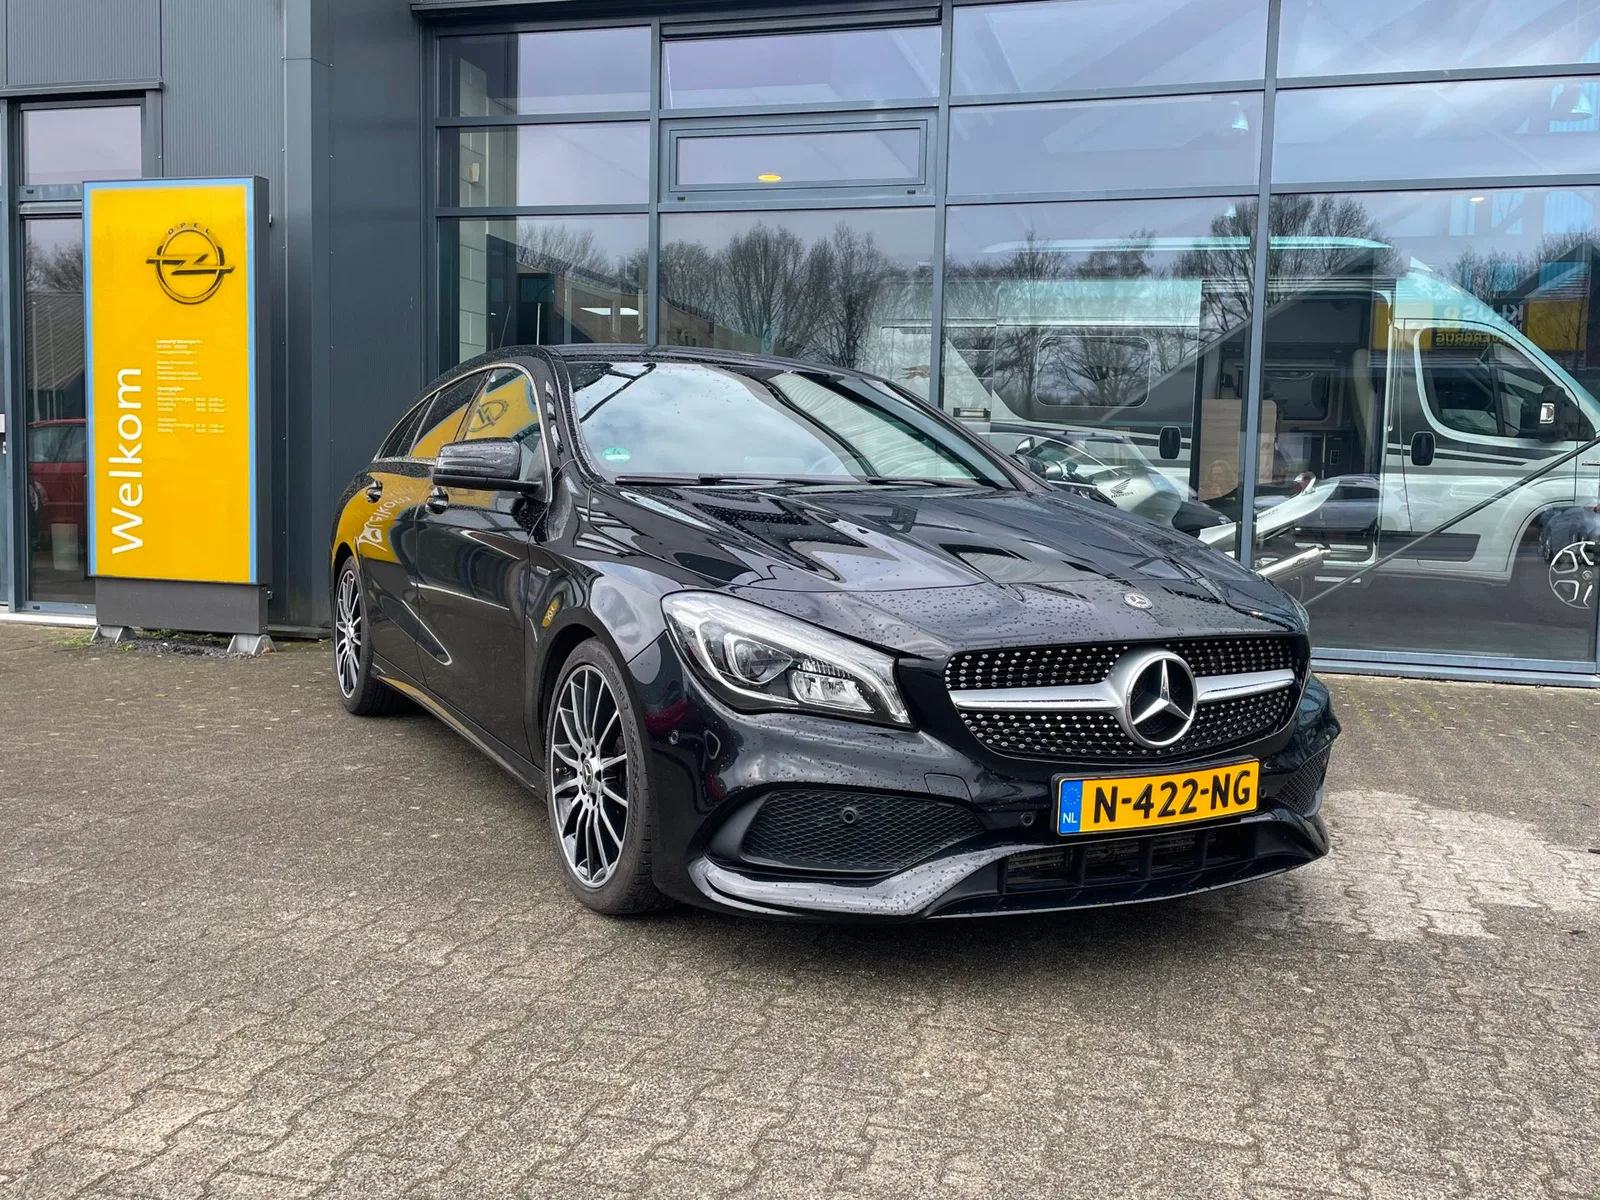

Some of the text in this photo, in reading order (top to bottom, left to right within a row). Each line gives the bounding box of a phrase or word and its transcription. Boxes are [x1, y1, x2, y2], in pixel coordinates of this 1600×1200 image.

[168, 222, 209, 235] OPEL
[108, 368, 143, 554] Welkom
[1093, 770, 1251, 824] N-422-NG
[1062, 812, 1078, 824] NL
